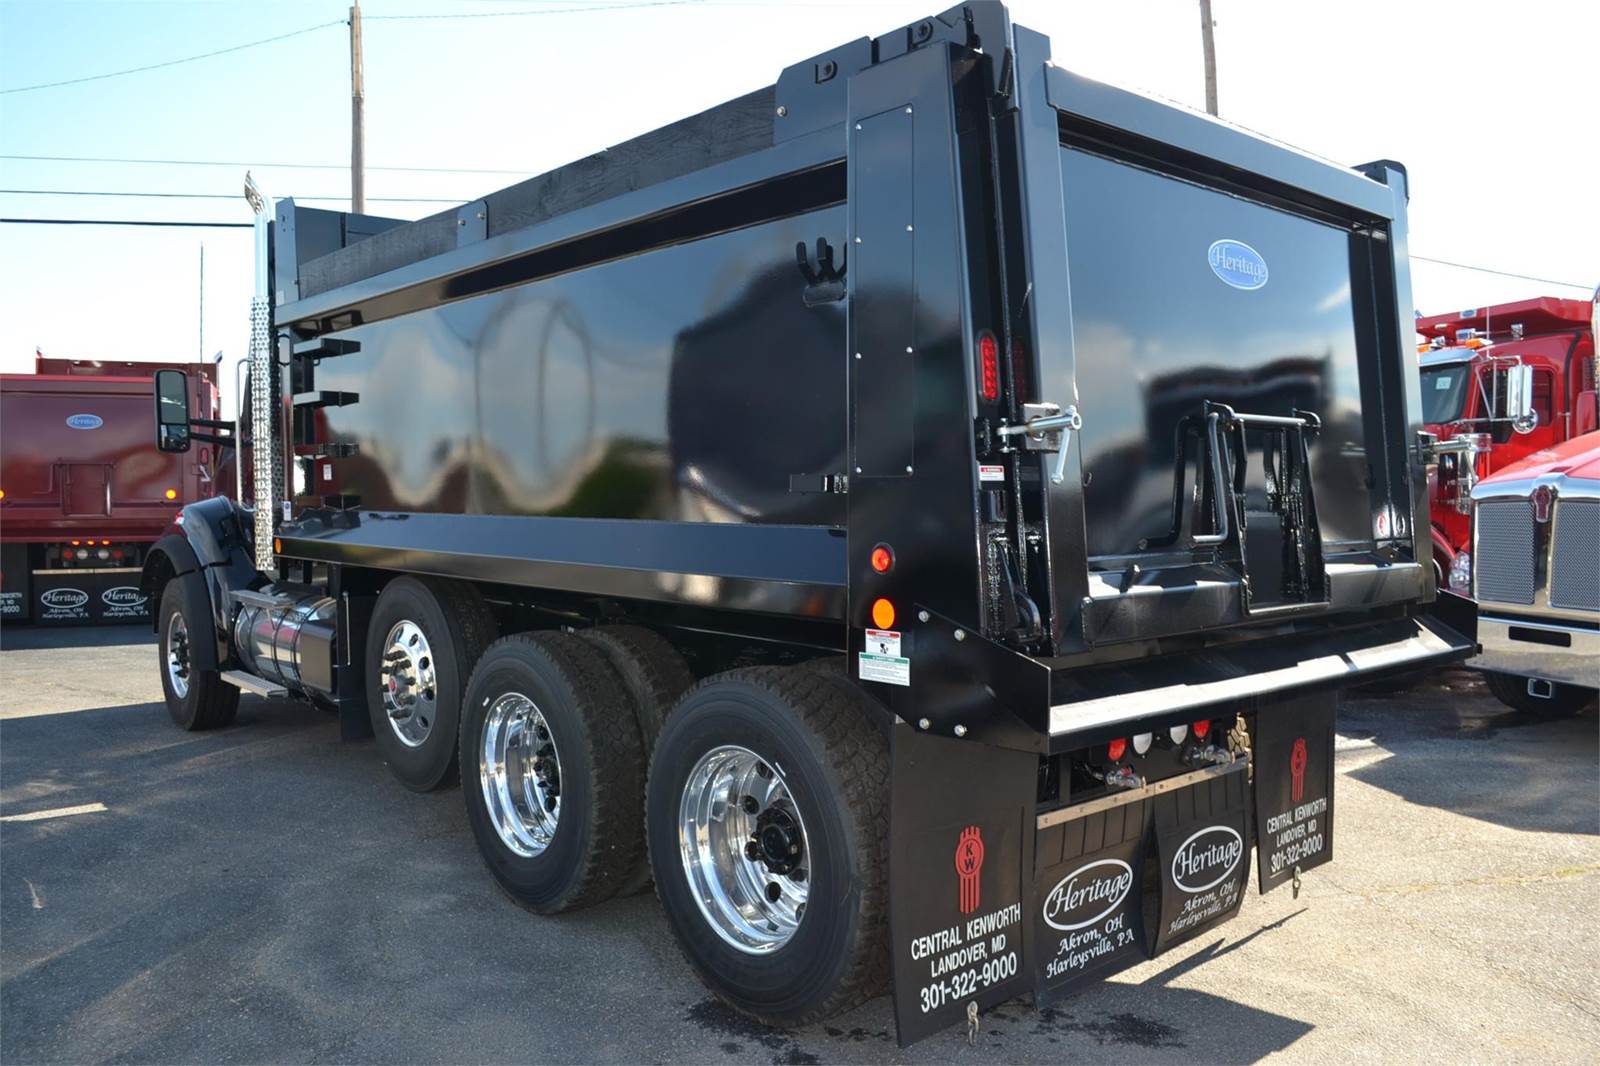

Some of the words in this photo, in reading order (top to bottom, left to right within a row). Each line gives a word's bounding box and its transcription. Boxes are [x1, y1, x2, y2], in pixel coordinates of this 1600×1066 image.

[1211, 245, 1265, 283] Heritage
[45, 591, 87, 604] Heritage
[1266, 810, 1293, 834] CENTRAL
[1294, 797, 1327, 822] KENWORTH
[1307, 818, 1317, 834] MD
[963, 855, 976, 871] W
[965, 842, 974, 857] K
[1176, 840, 1239, 880] Heritage
[1271, 833, 1323, 873] 301-322-9000
[1048, 872, 1129, 918] Heritage
[1168, 899, 1221, 935] Harleysville,
[1224, 892, 1238, 908] PA
[1181, 892, 1216, 914] Akron,
[1219, 878, 1236, 897] OH
[911, 925, 962, 961] CENTRAL
[966, 902, 1021, 941] KENWORTH
[1057, 929, 1102, 955] Akron,
[1104, 912, 1124, 934] OH
[931, 941, 988, 978] LANDOVER,
[991, 934, 1006, 954] MD
[1046, 936, 1115, 979] Harleysville,
[1117, 928, 1135, 947] PA
[920, 951, 1017, 1013] 301-322-9000
